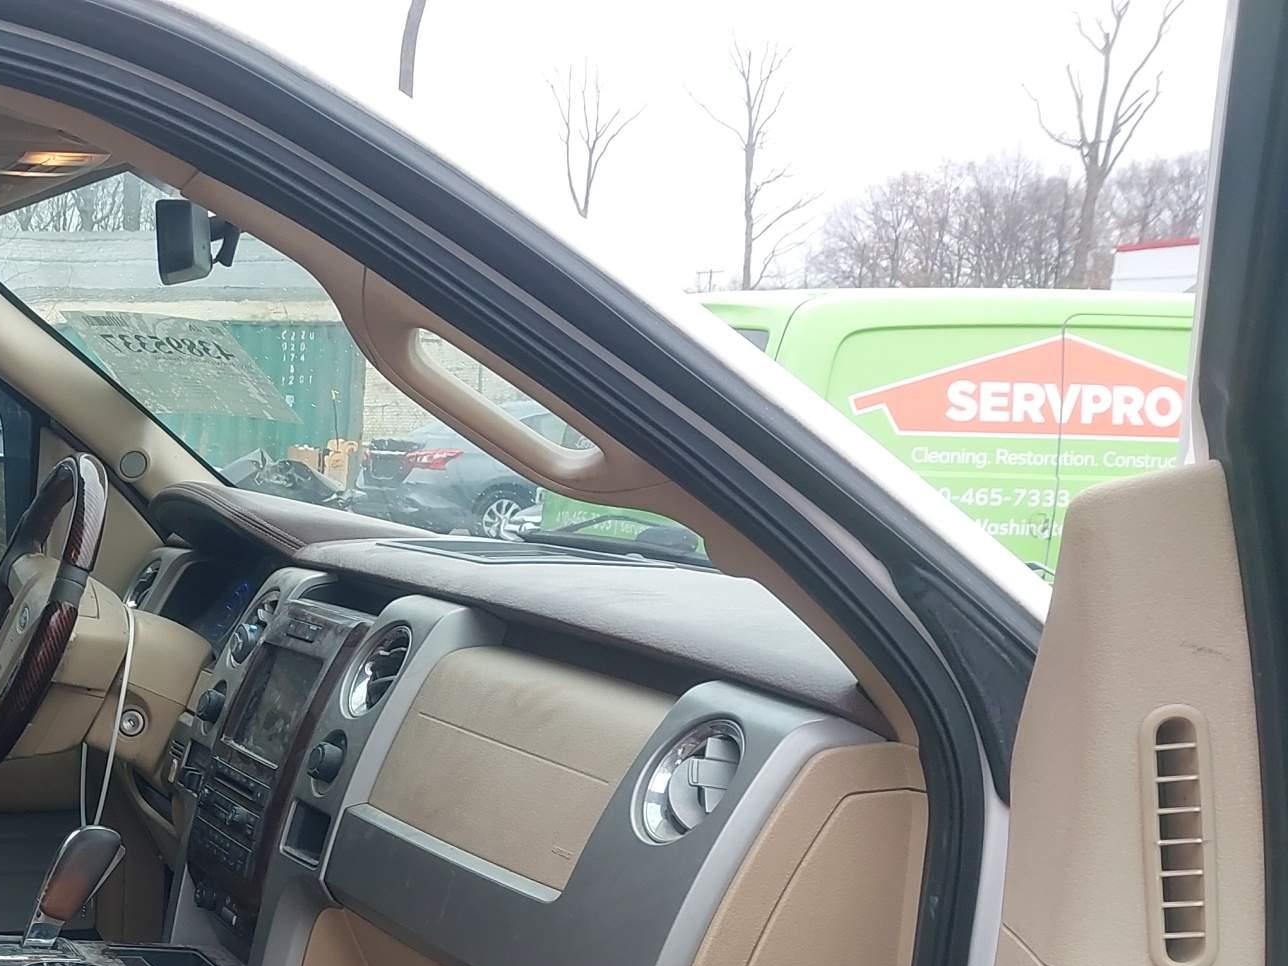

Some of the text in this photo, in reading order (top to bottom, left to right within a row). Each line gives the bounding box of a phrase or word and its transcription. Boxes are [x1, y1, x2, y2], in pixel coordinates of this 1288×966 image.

[945, 380, 1183, 428] SERVPRO
[912, 446, 991, 469] Cleaning.
[996, 449, 1097, 468] Restoration.
